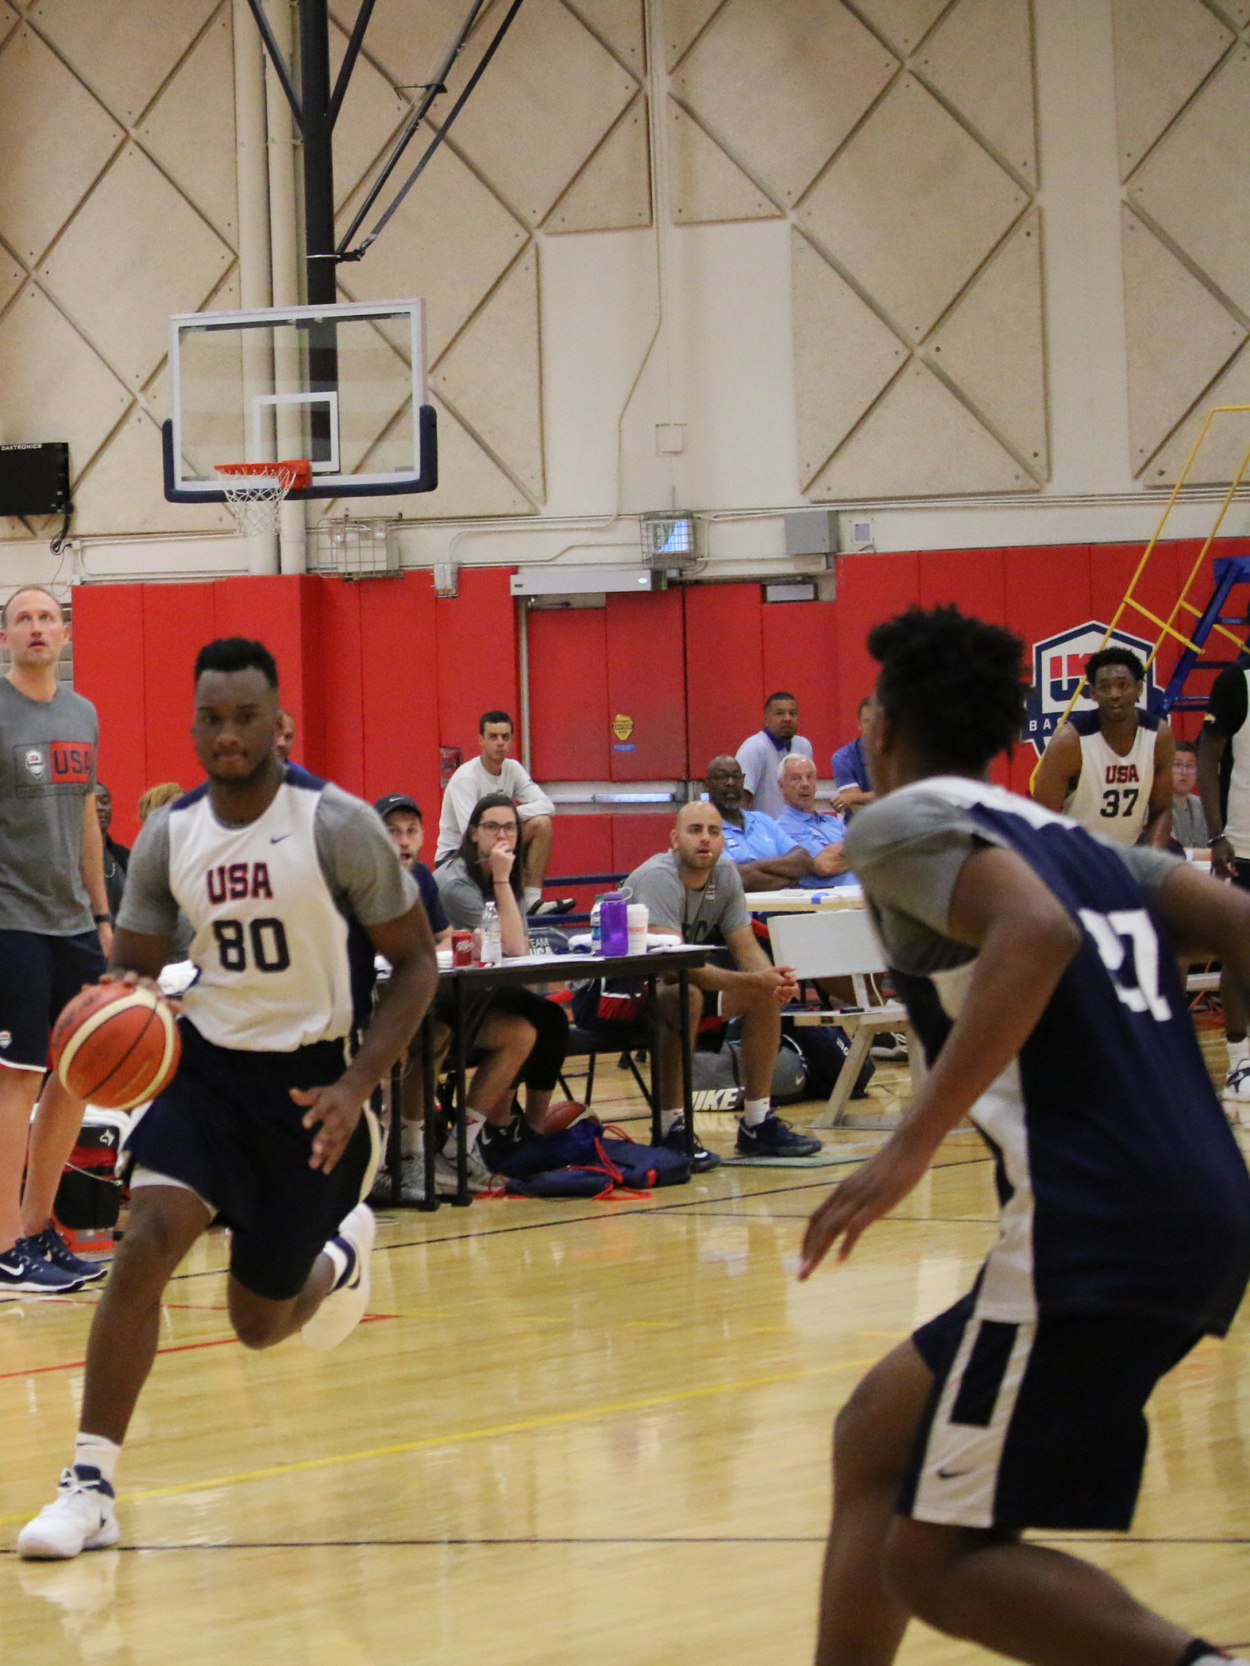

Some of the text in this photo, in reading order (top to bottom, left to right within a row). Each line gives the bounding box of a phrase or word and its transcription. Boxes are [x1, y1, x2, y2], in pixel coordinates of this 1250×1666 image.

[1106, 764, 1139, 784] USA
[1100, 788, 1139, 818] 37
[207, 862, 273, 905] USA
[212, 918, 290, 972] 80
[530, 937, 549, 948] EAM
